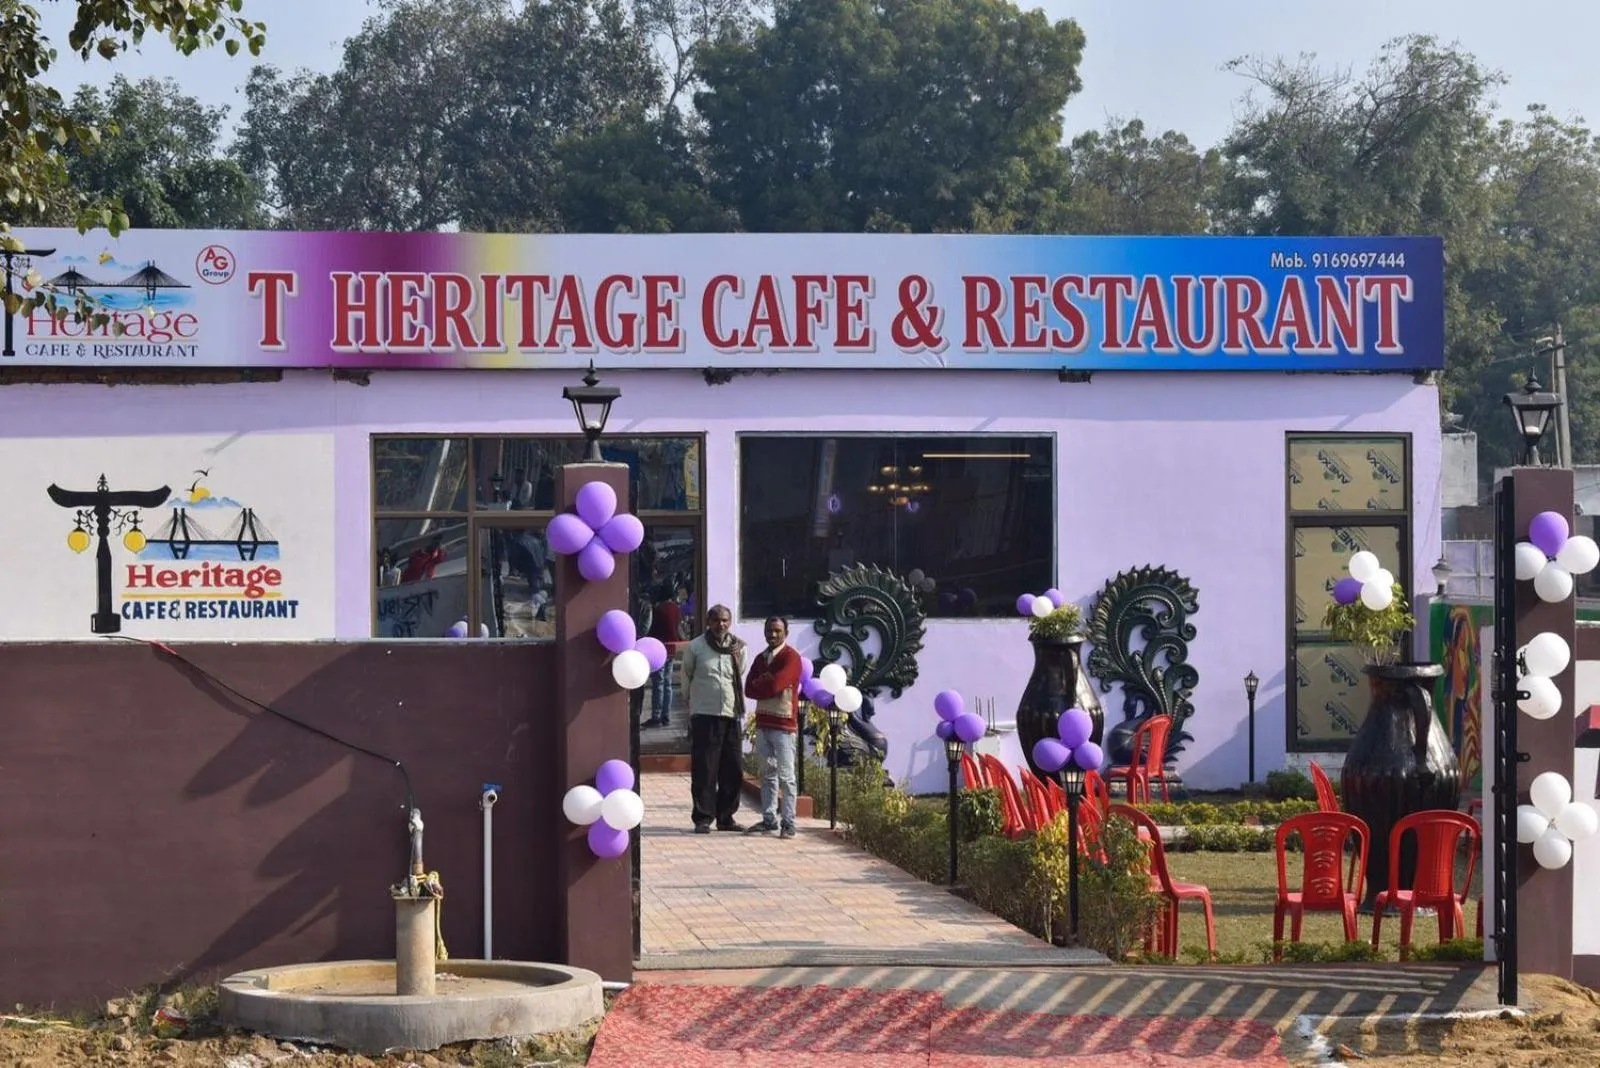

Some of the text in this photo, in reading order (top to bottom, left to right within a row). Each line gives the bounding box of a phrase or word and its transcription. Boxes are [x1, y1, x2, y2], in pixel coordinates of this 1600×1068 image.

[204, 248, 228, 270] AG
[1271, 252, 1405, 268] Mob. 9169697444
[202, 269, 229, 278] Group
[248, 272, 1412, 353] T HERITAGE CAFE & RESTAURANT
[25, 343, 70, 357] CAFE
[93, 344, 199, 359] RESTAURANT
[126, 562, 282, 598] Heritage
[122, 601, 166, 619] CAFE
[185, 600, 299, 619] RESTAURANT
